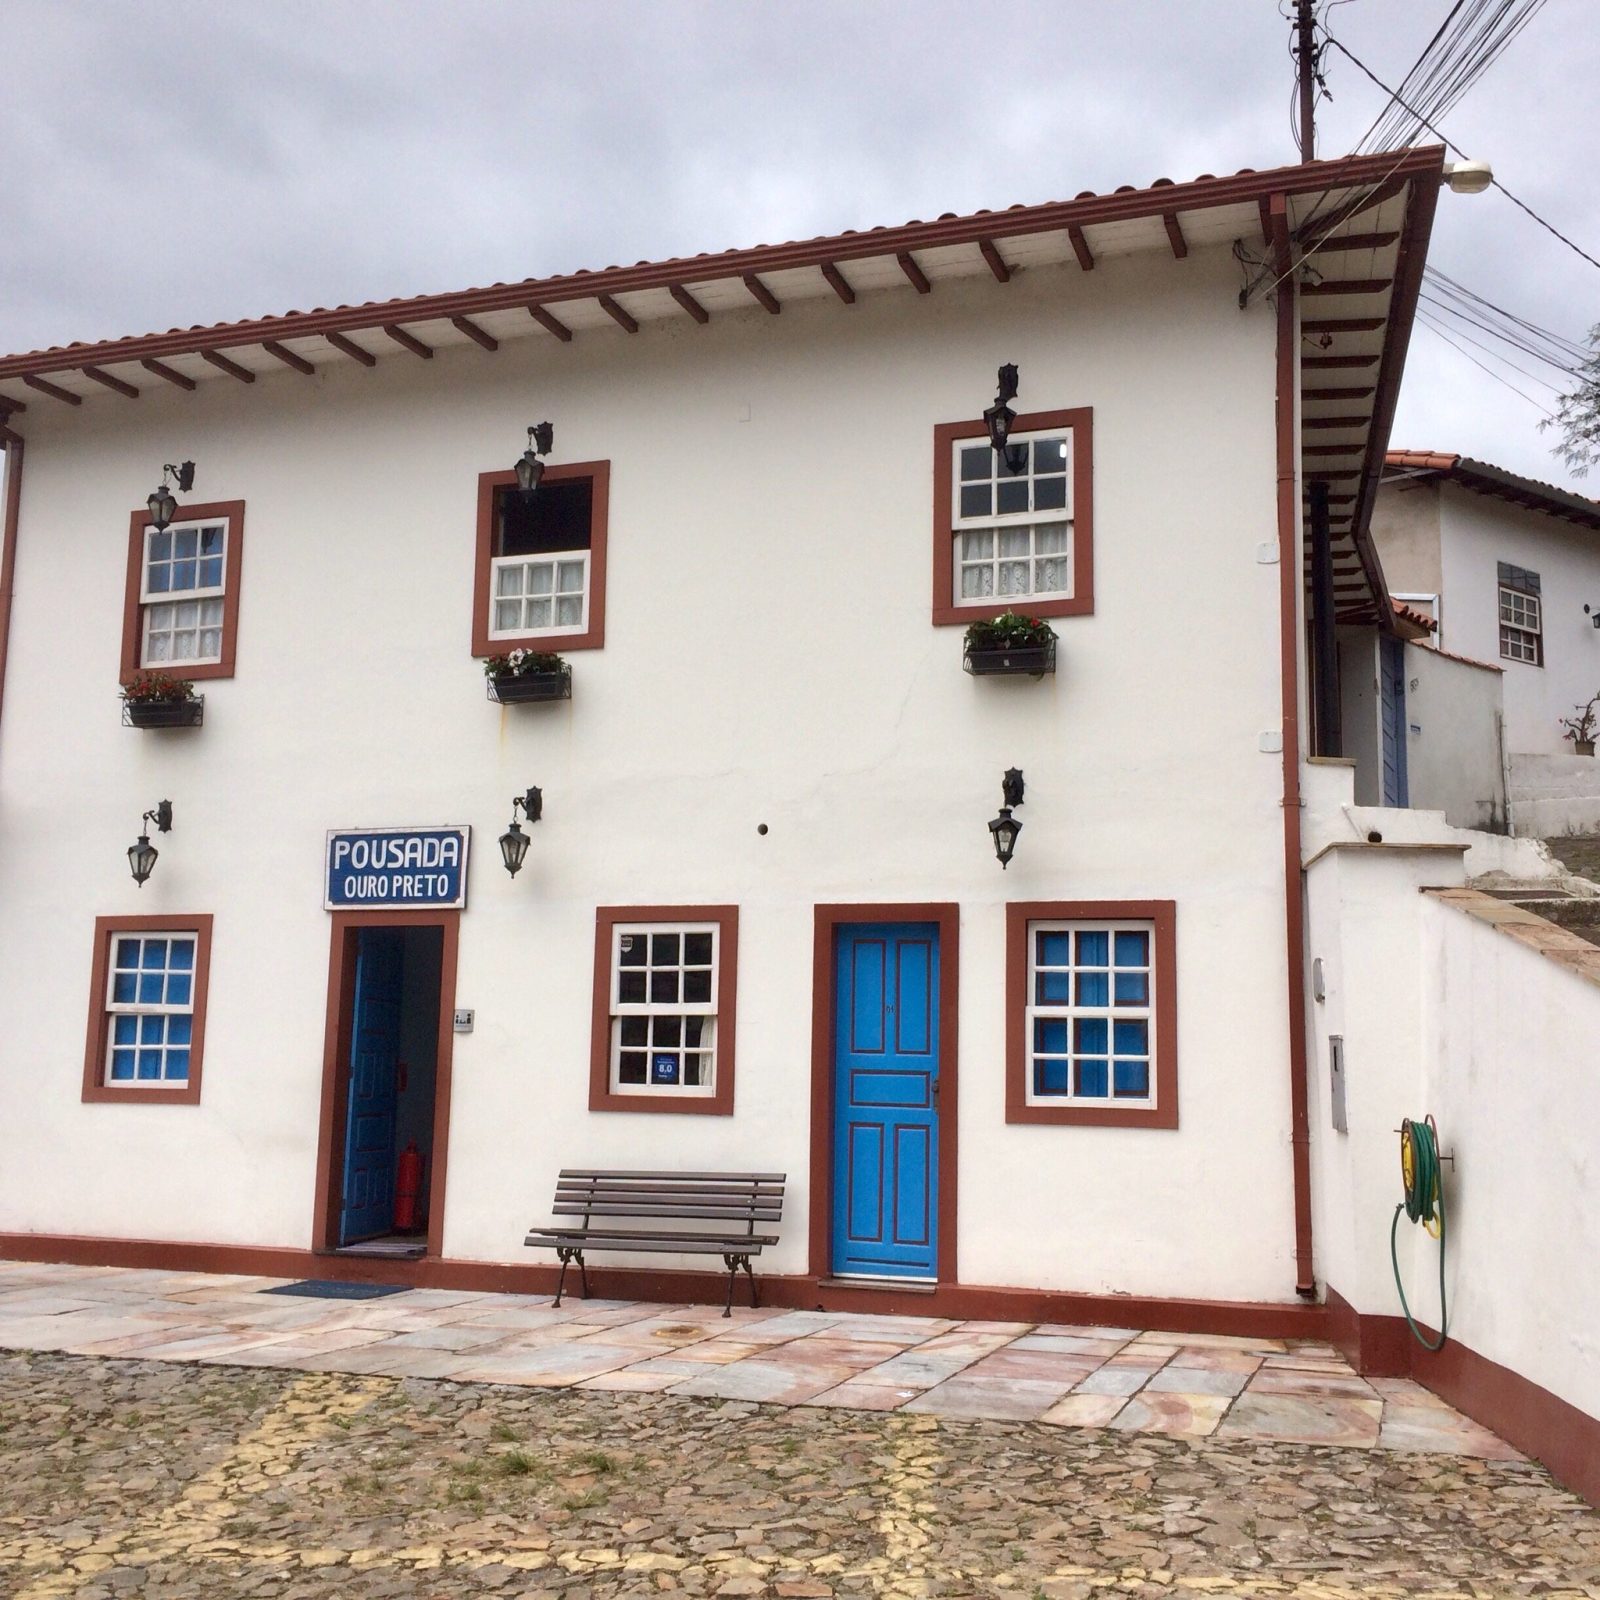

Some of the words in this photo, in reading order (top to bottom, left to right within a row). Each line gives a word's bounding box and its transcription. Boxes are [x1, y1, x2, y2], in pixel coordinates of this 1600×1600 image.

[334, 837, 459, 869] POUSADA
[344, 875, 388, 898] OURO
[392, 874, 449, 897] PRETO
